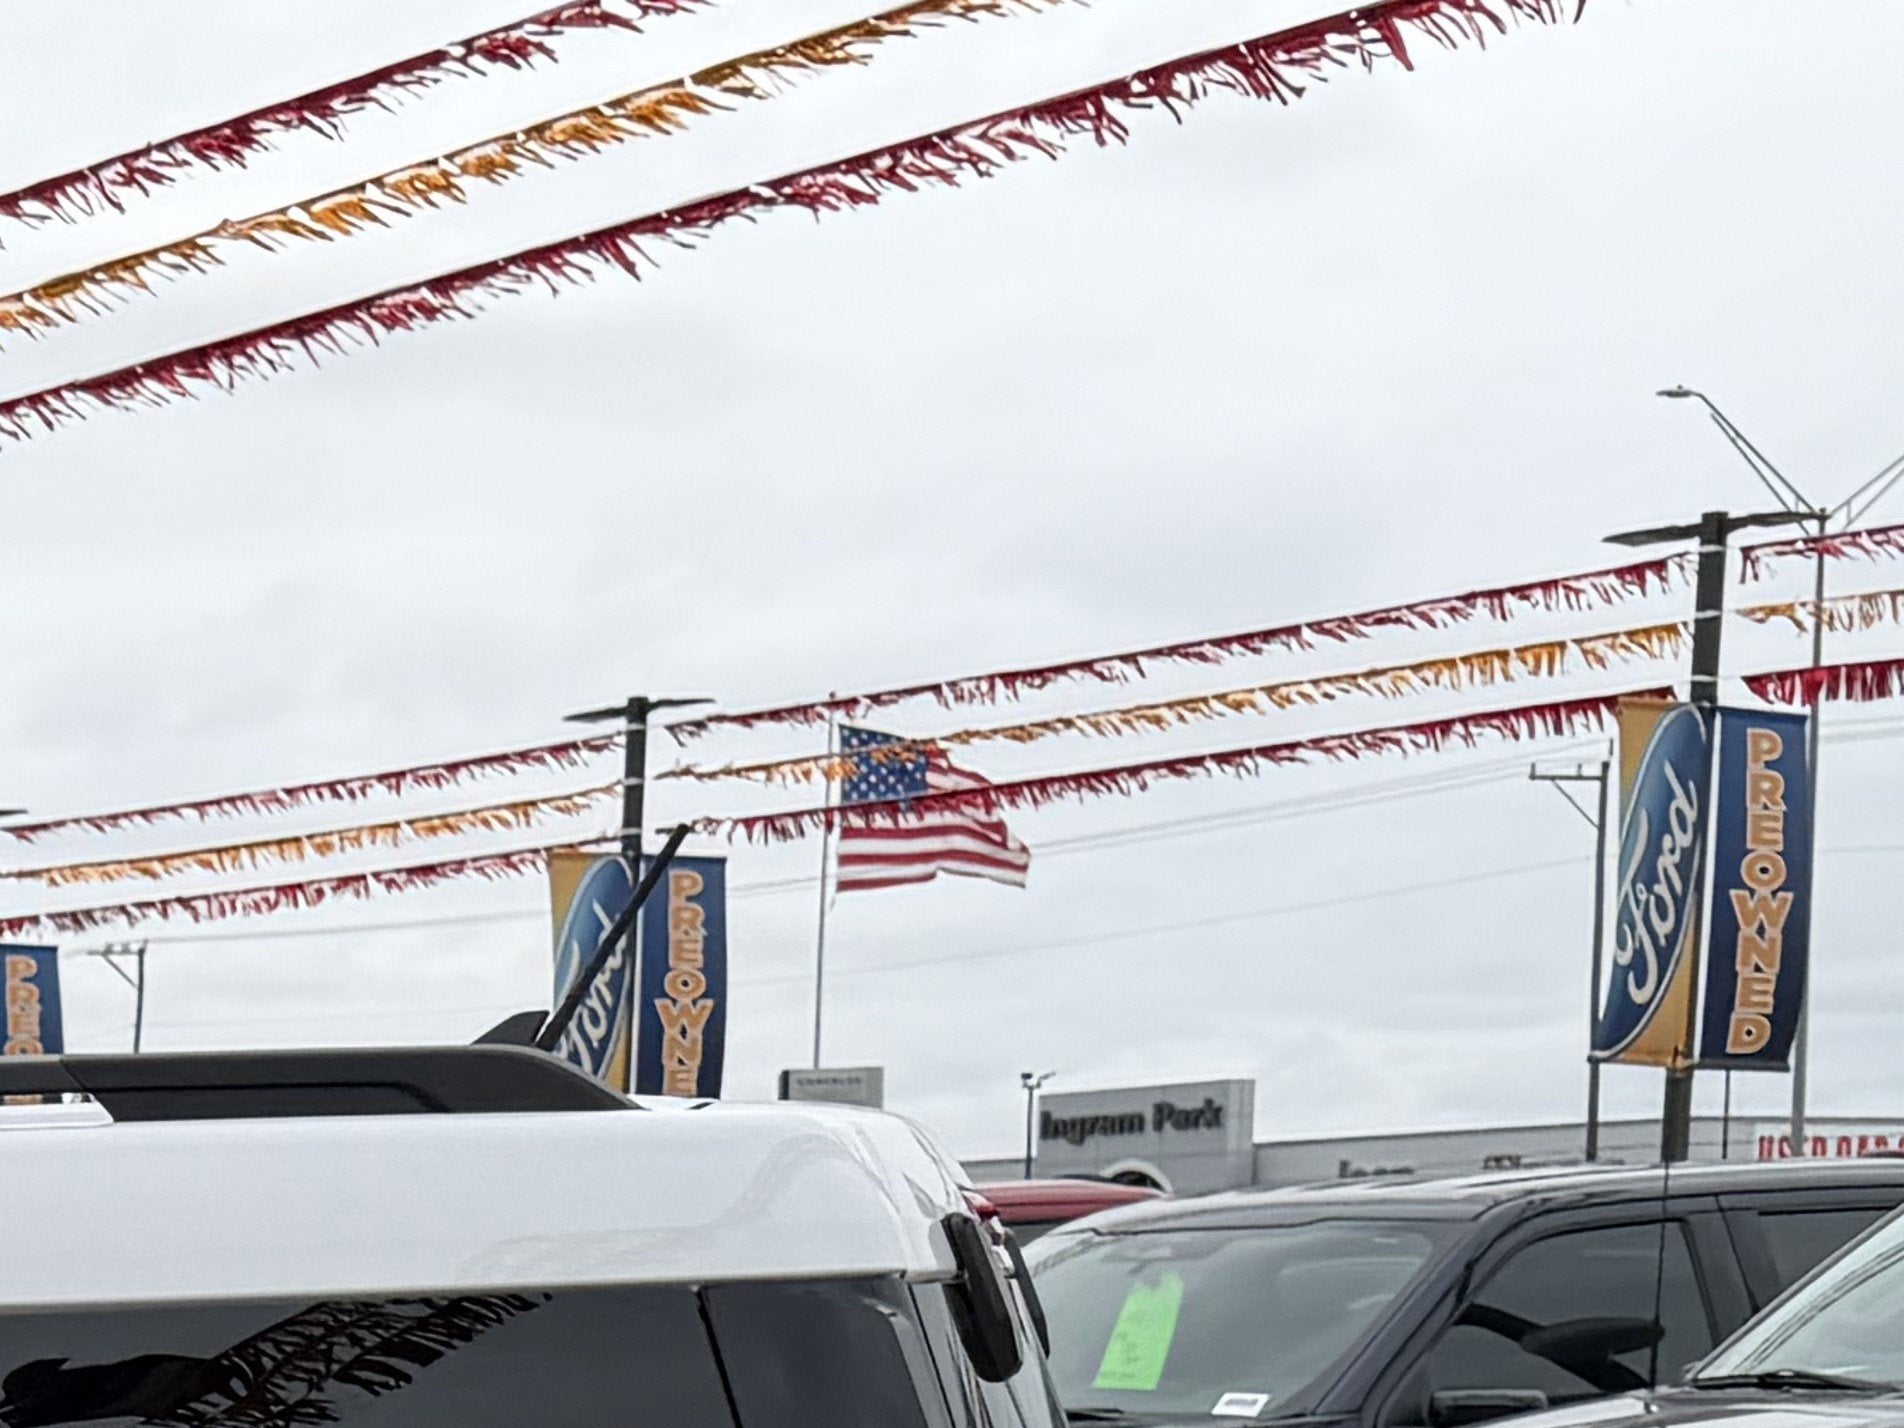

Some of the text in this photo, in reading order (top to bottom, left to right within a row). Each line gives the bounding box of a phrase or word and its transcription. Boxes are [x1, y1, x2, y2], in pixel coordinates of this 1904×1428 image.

[654, 869, 715, 1096] PREOWNE
[1616, 759, 1698, 1004] Ford
[1725, 727, 1794, 1054] PREOWNED
[1039, 1098, 1225, 1146] Ingram Park
